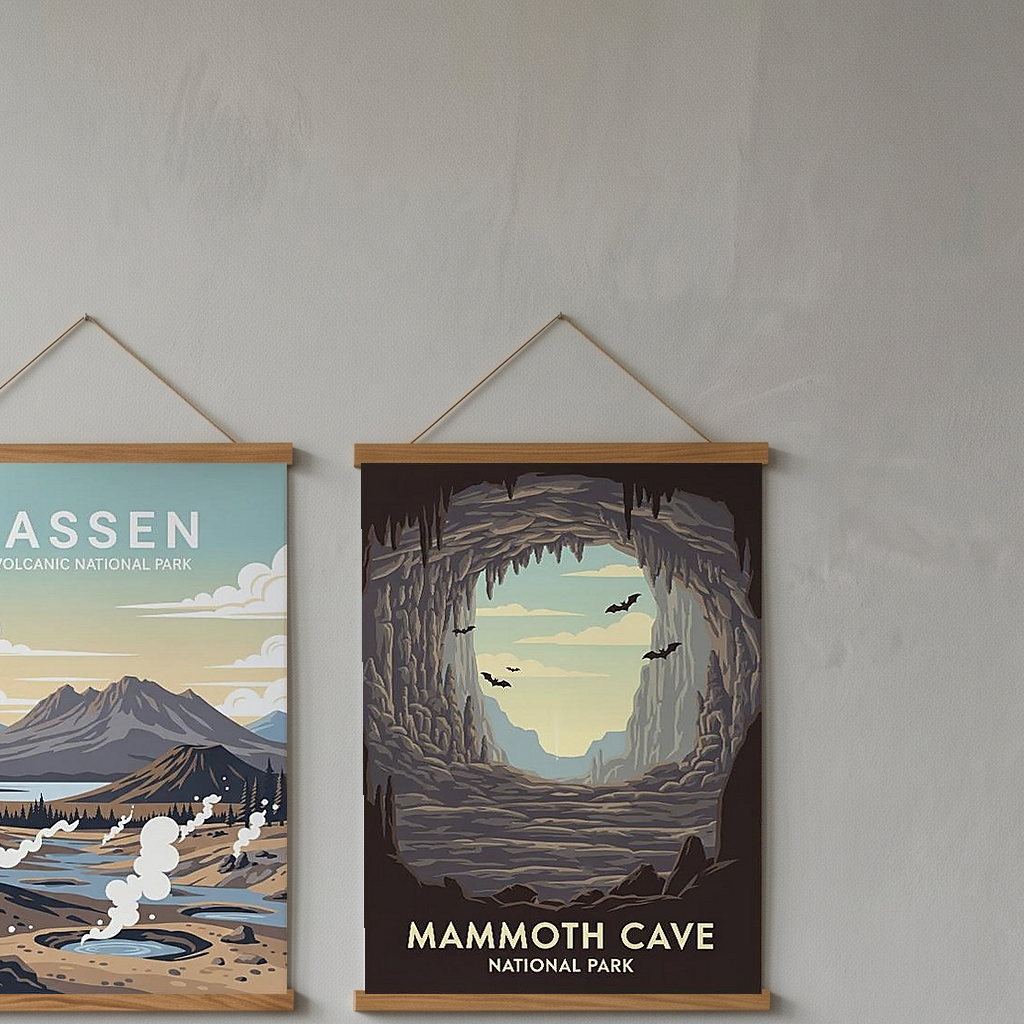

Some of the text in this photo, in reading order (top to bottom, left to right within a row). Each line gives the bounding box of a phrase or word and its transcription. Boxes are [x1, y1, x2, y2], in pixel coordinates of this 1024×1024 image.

[75, 558, 150, 572] NATIONAL
[155, 558, 193, 572] PARK
[407, 921, 715, 950] MAMMOTH CAVE
[488, 958, 635, 973] NATIONAL PARK
